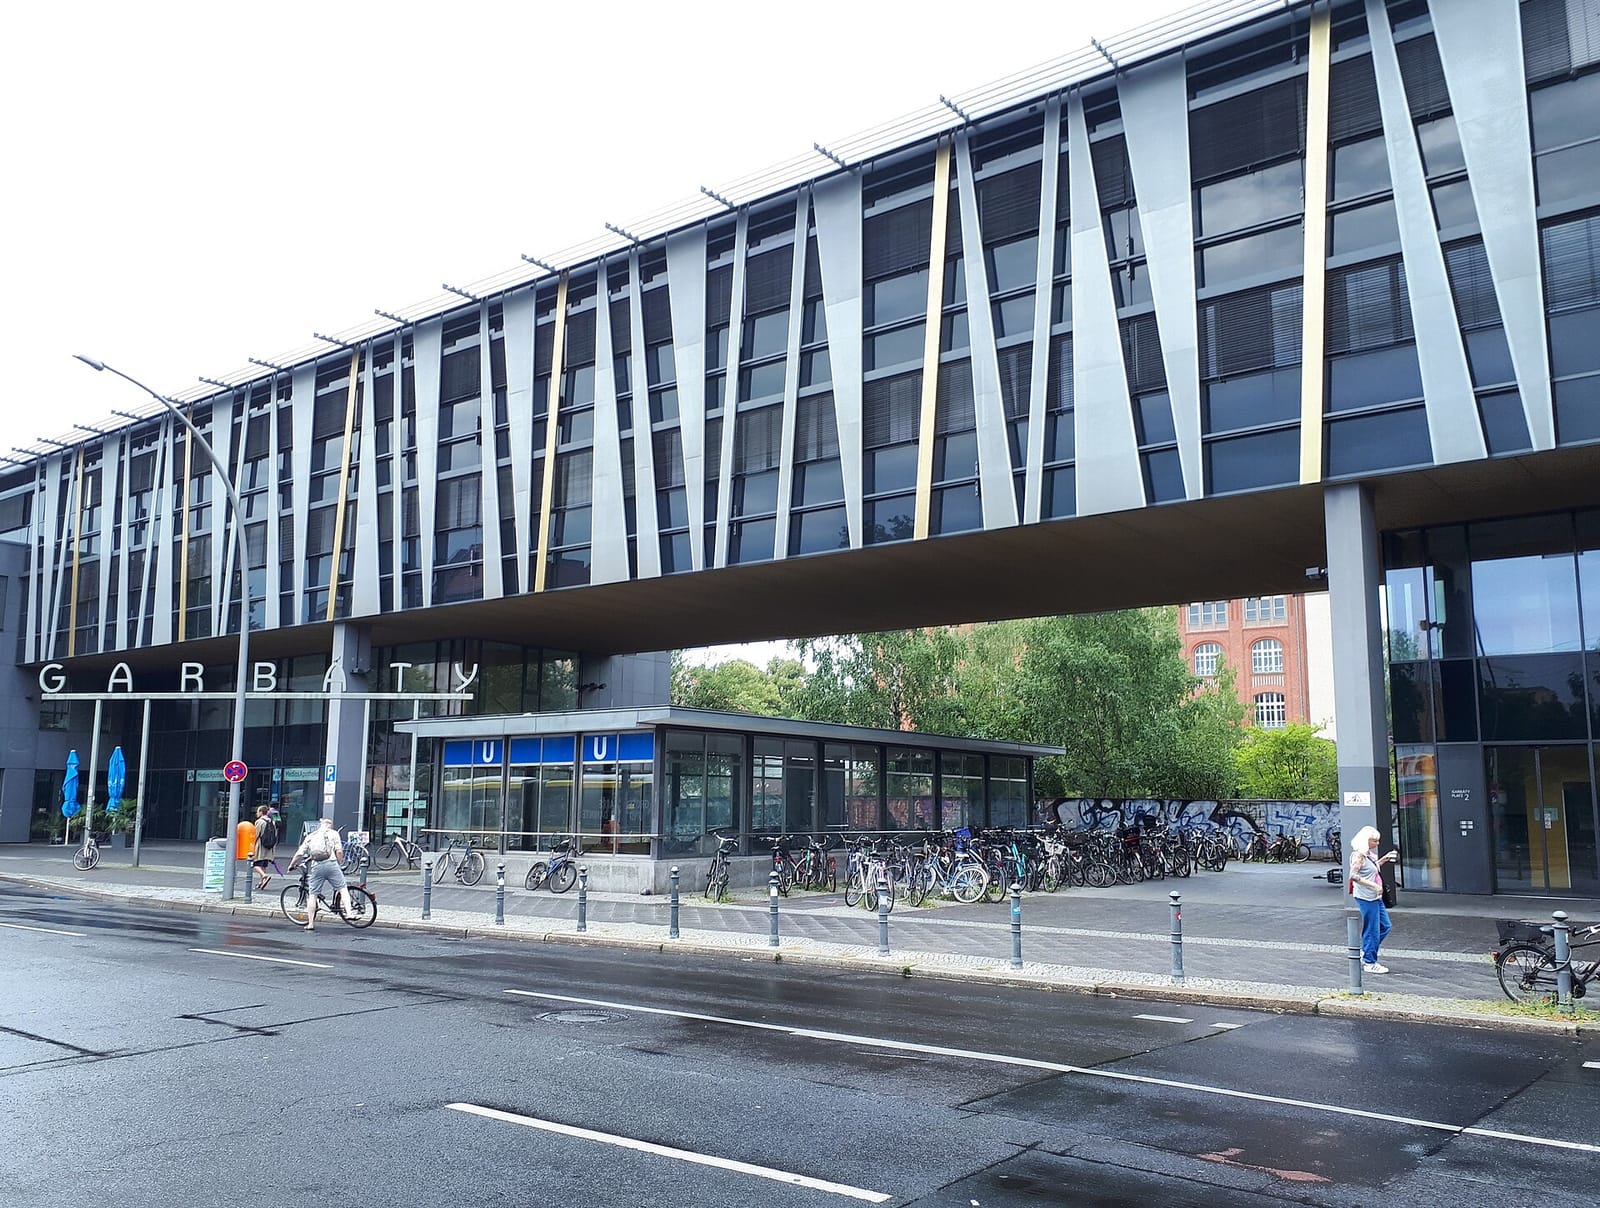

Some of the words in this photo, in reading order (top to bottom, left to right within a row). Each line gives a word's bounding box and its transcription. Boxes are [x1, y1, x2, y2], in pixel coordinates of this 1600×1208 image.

[482, 741, 494, 763] U
[593, 737, 607, 760] U
[327, 766, 334, 779] P
[1464, 793, 1470, 801] 2
